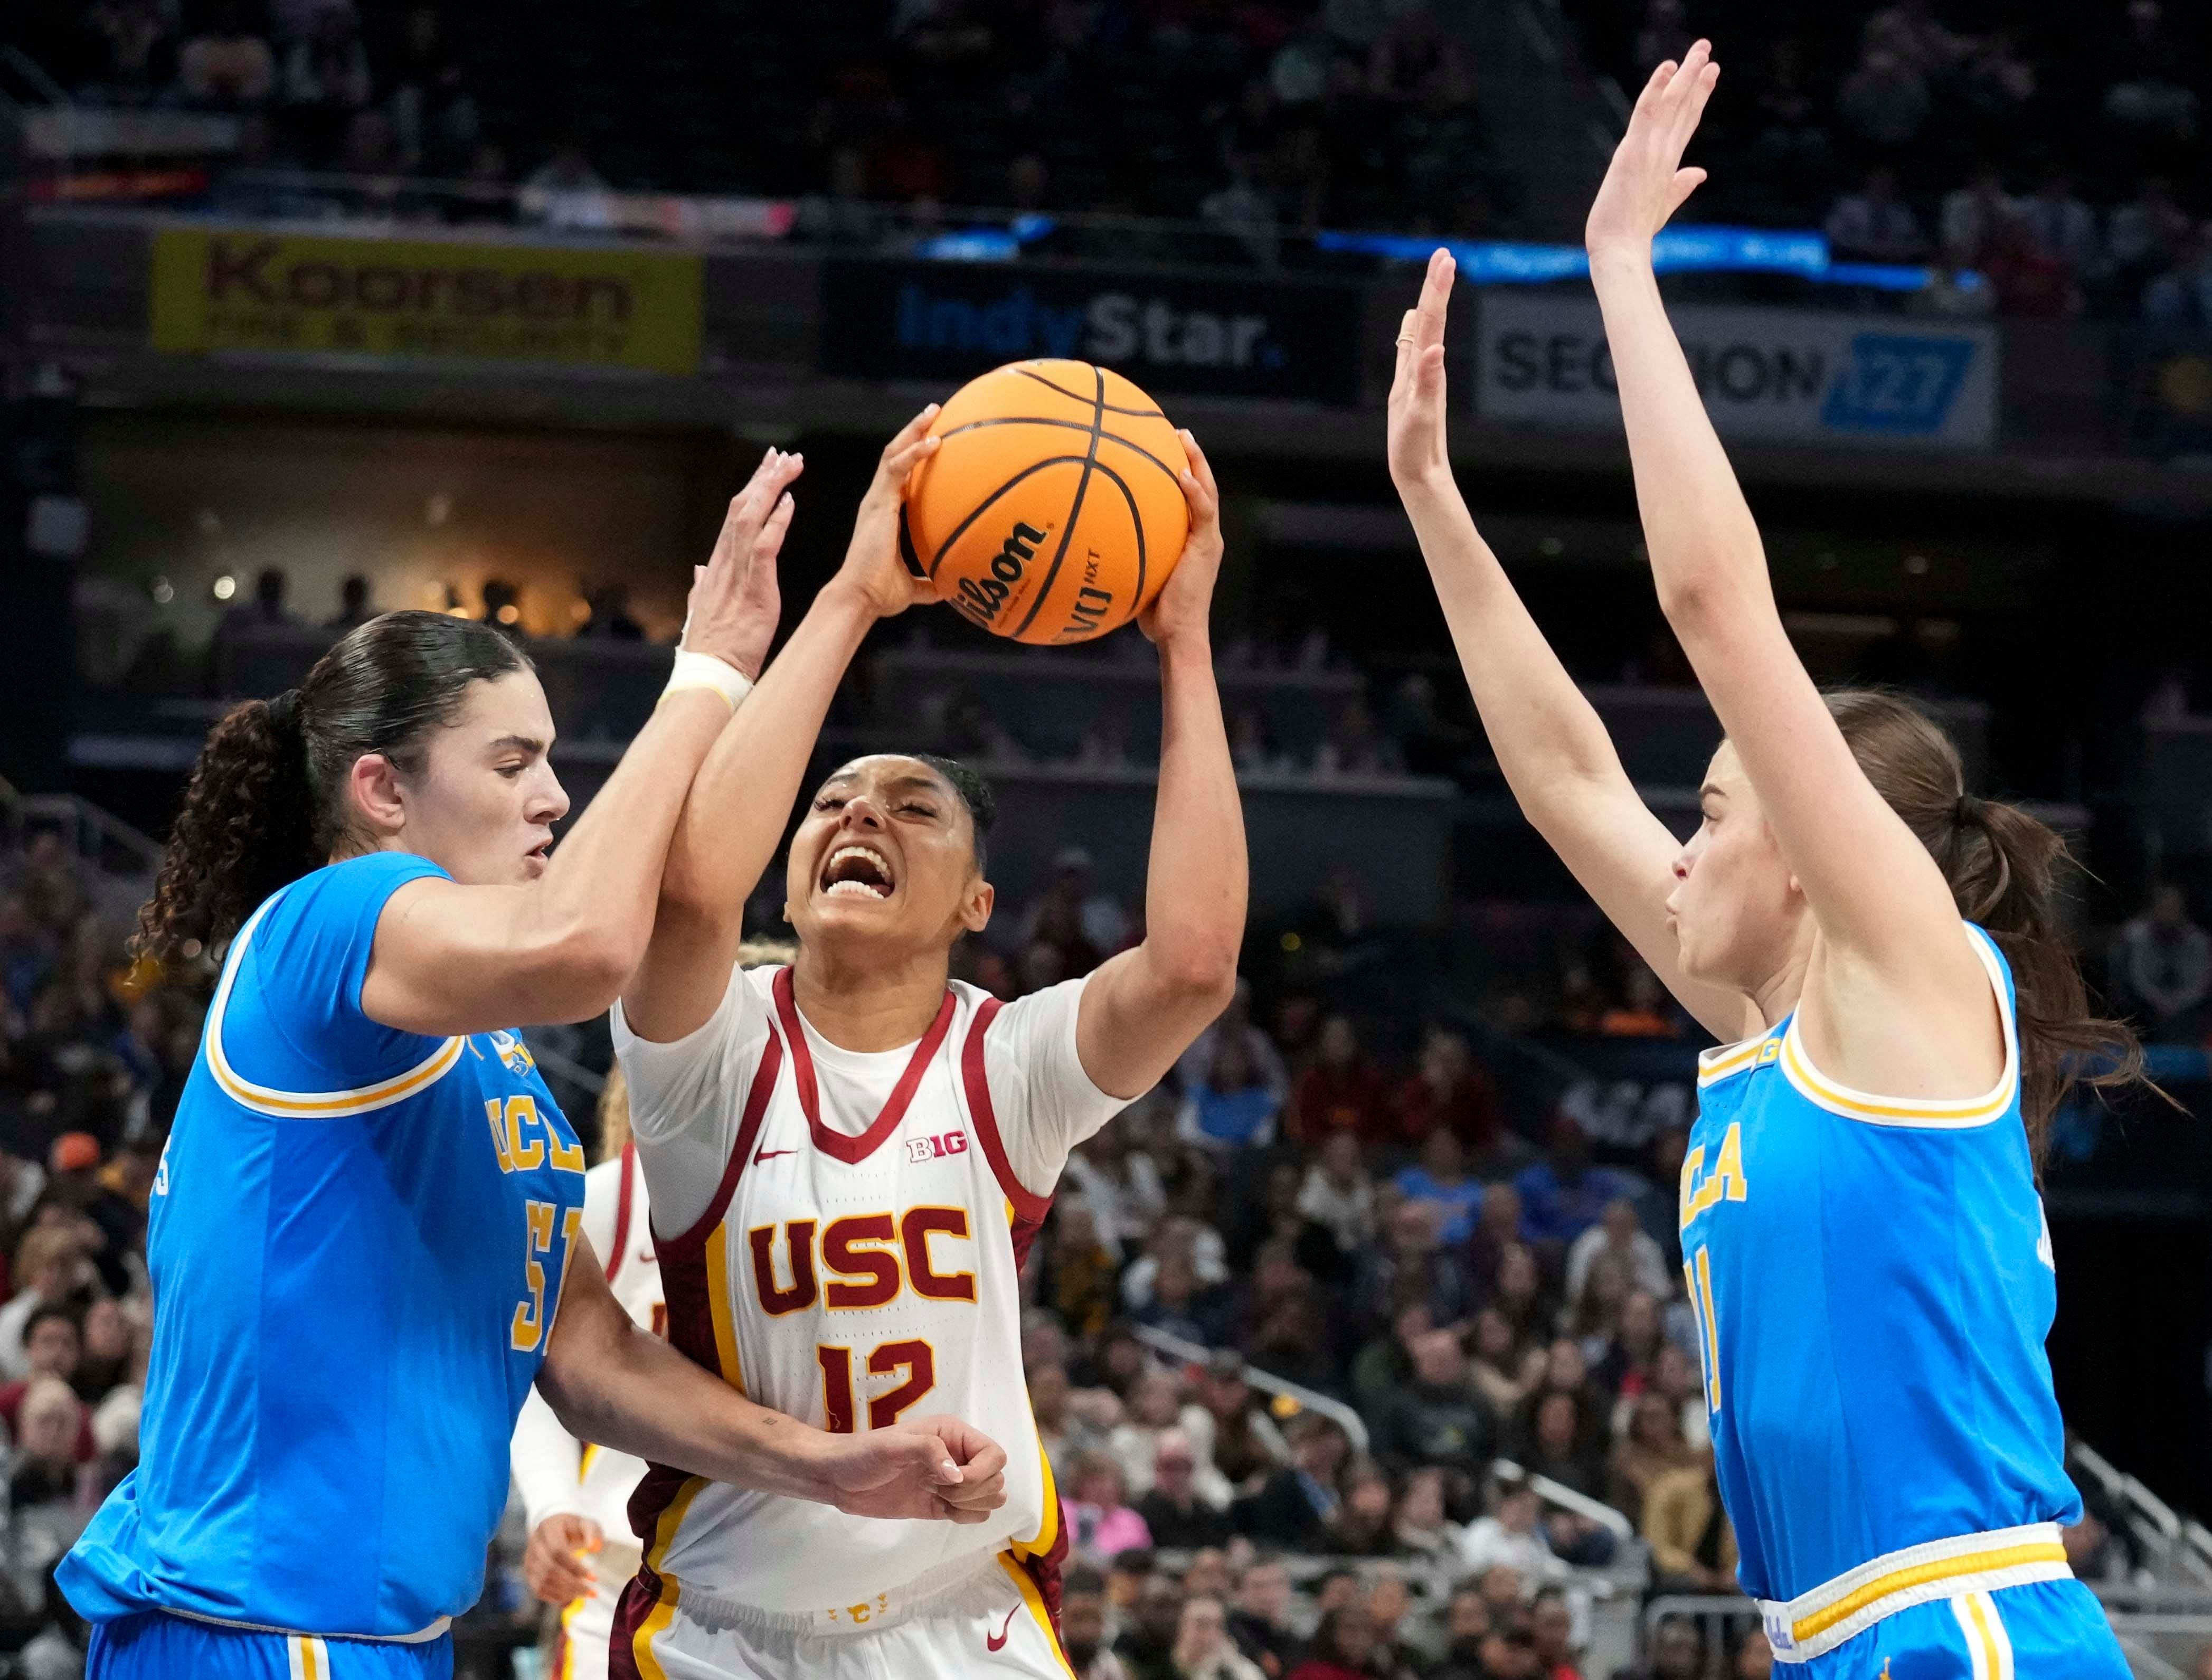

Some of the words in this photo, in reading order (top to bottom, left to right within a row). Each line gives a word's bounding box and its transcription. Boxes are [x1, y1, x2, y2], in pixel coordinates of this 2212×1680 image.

[207, 235, 631, 321] Koorsen
[1496, 330, 1826, 404] SECION
[1063, 586, 1112, 632] VO
[484, 1095, 586, 1175] UCL
[1679, 1121, 1747, 1230] CLA
[749, 1204, 978, 1318] USC
[816, 1337, 937, 1434] 12
